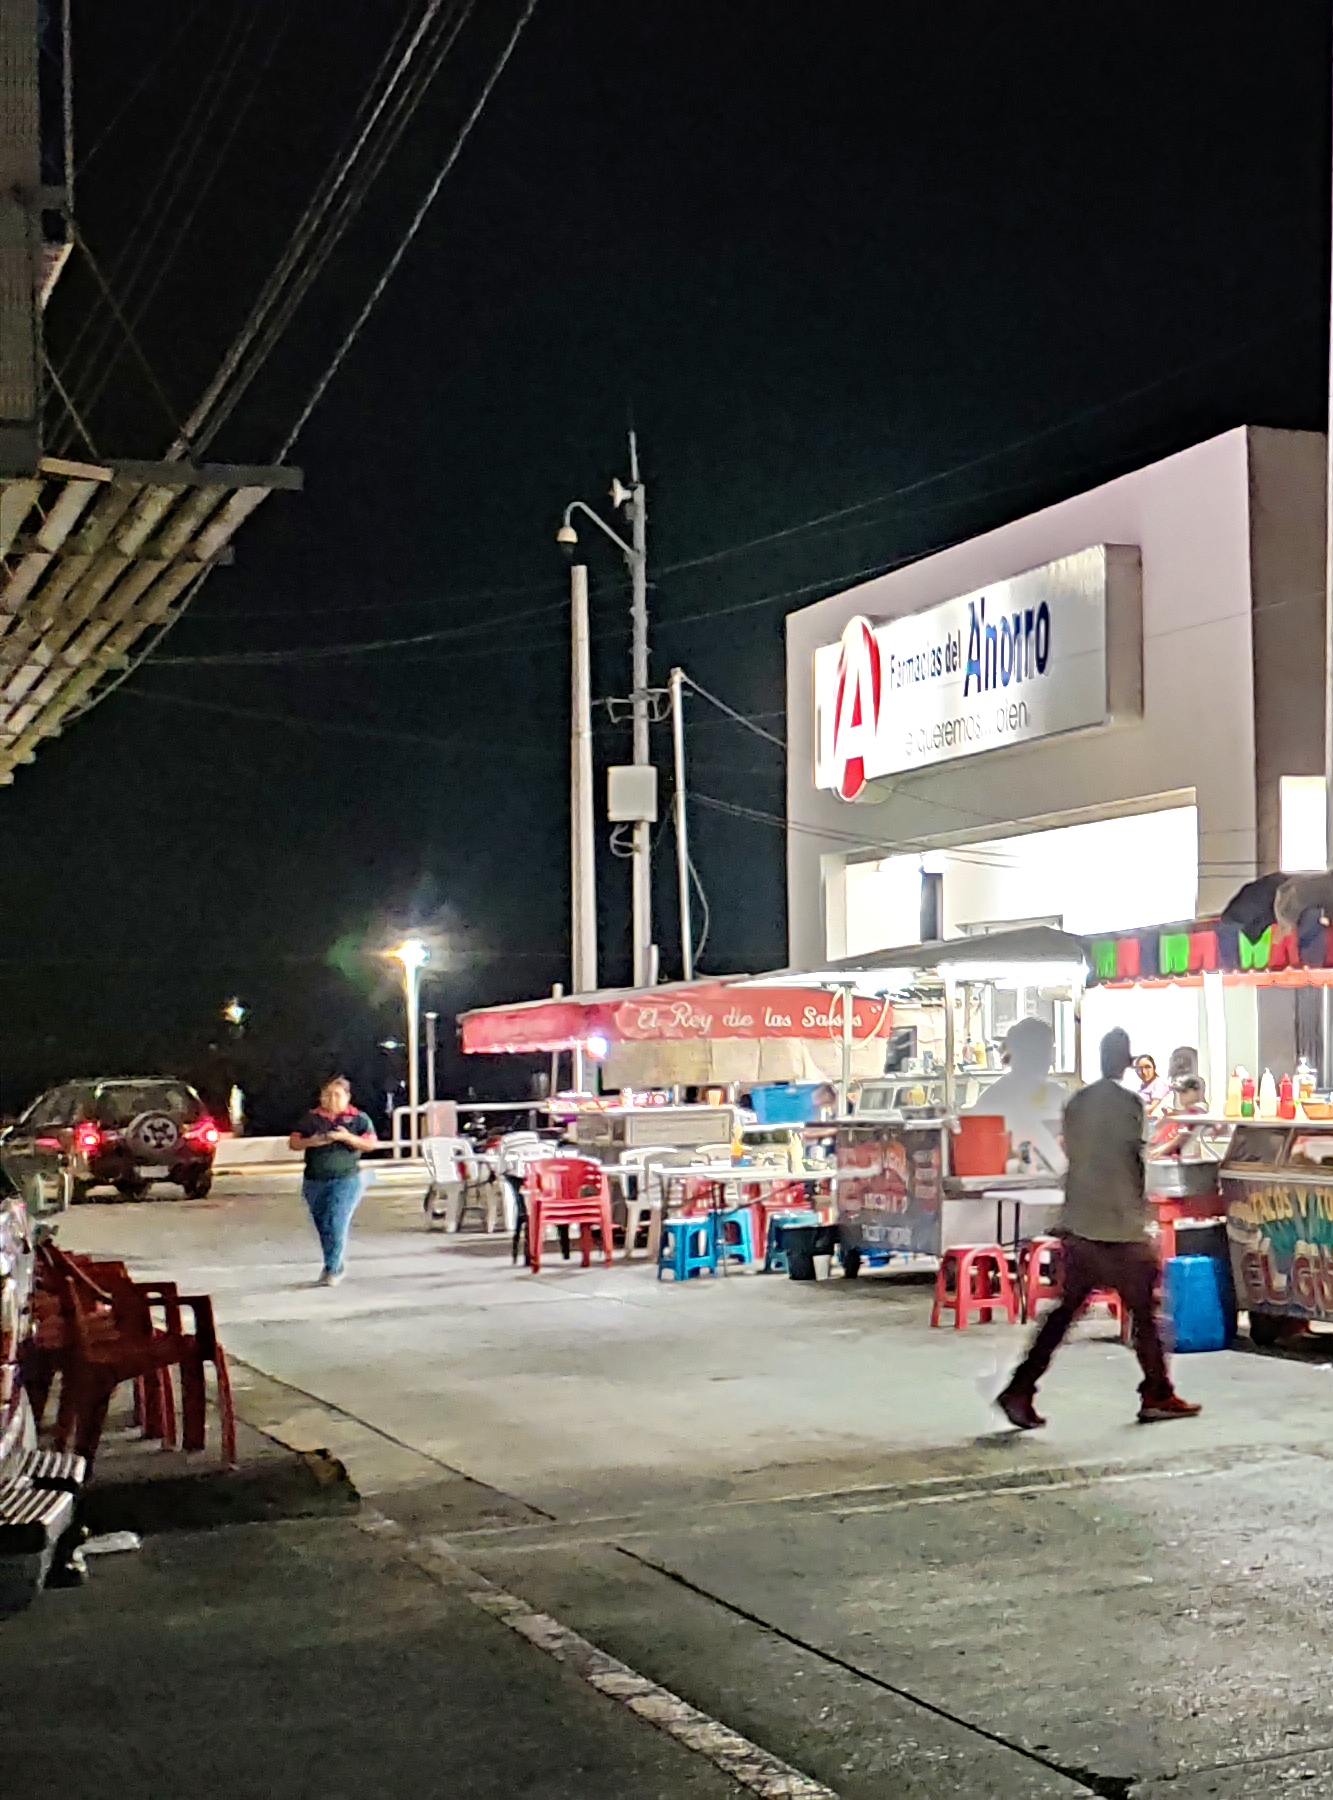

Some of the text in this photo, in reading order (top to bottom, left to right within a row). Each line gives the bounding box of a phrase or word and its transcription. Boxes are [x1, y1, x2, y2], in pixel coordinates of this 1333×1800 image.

[890, 597, 1050, 697] Farmacias del Ahorro
[669, 1001, 712, 1035] Rey
[1250, 1186, 1294, 1223] TACOS
[1295, 1186, 1308, 1218] Y
[1241, 1238, 1290, 1305] EL
